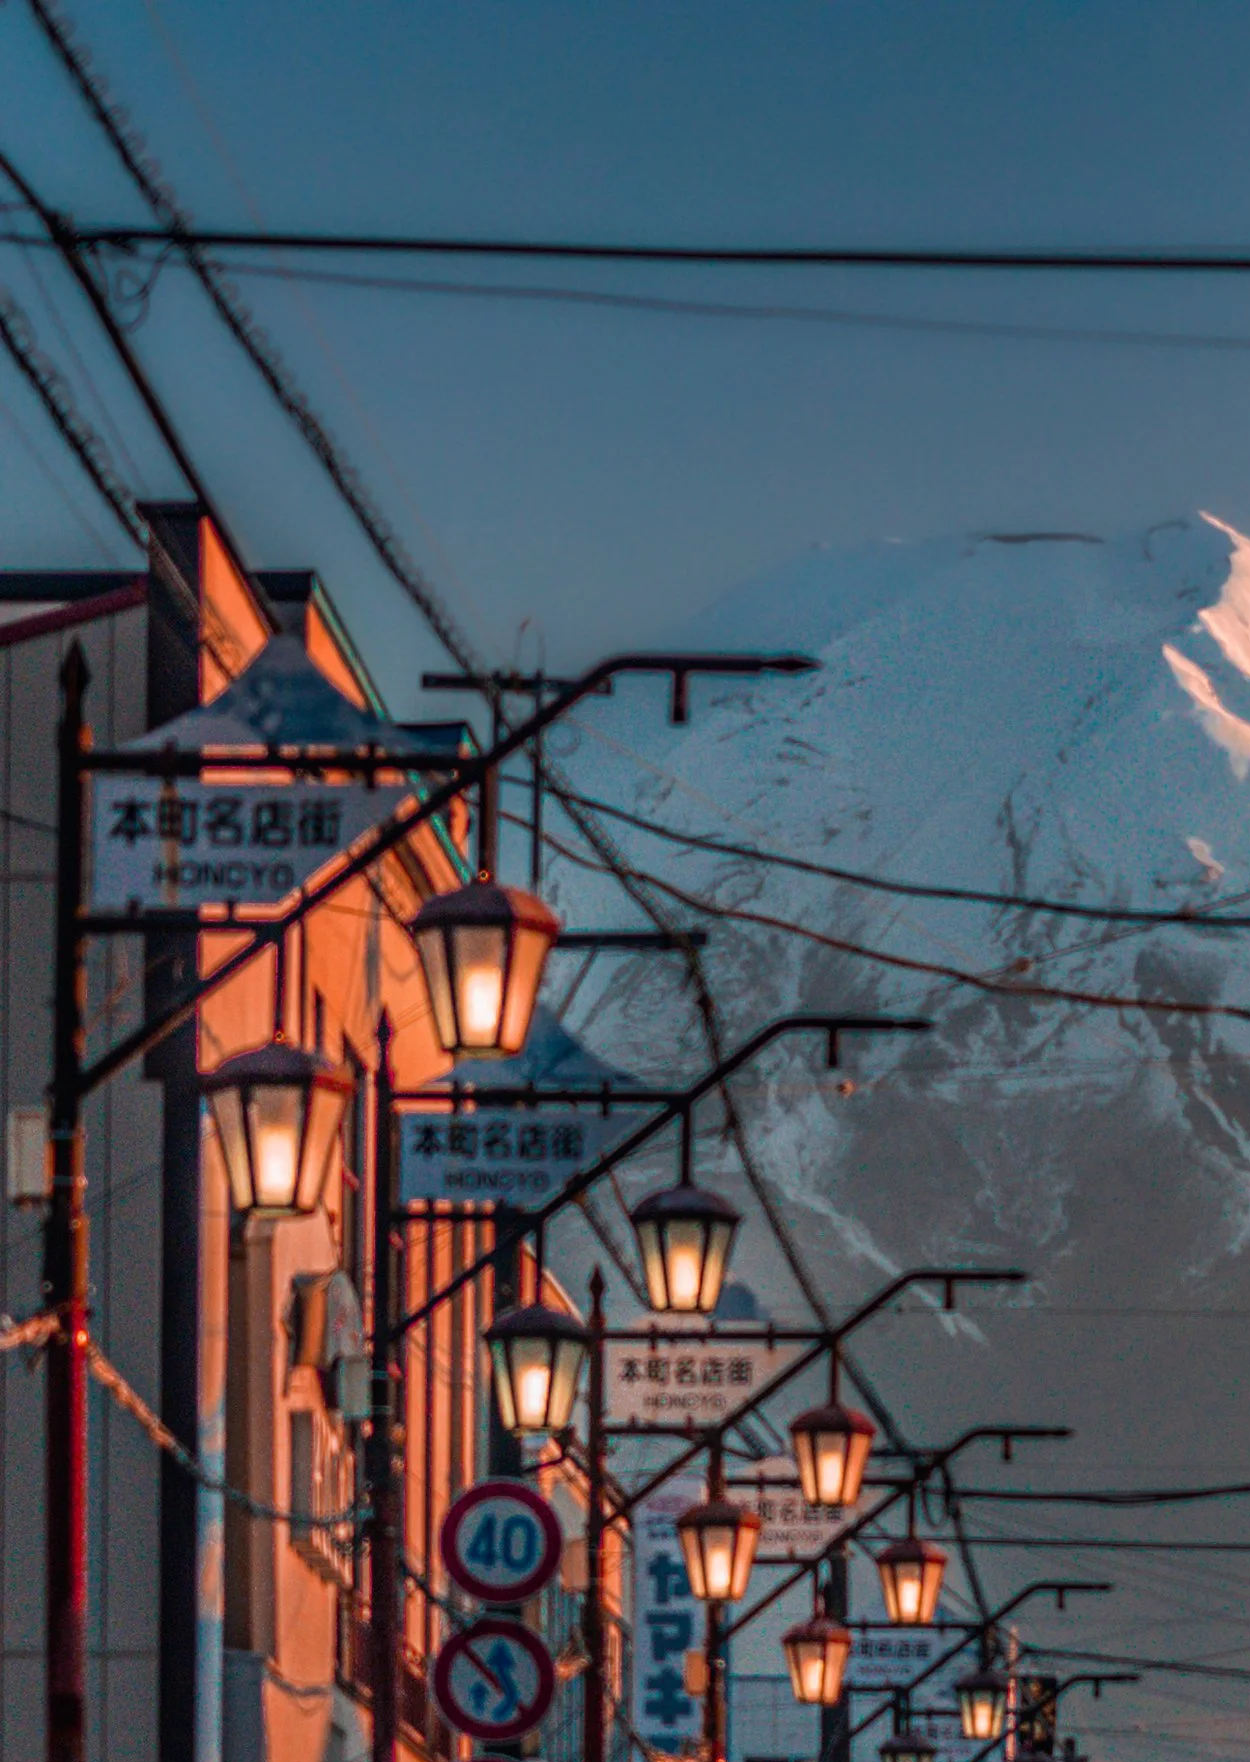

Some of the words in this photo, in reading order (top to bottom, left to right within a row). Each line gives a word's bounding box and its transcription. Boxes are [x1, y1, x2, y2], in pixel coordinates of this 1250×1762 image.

[109, 796, 342, 848] 本町名店街
[413, 1121, 584, 1161] 本町名店街
[618, 1356, 753, 1387] 本町名店街
[466, 1512, 537, 1573] 40
